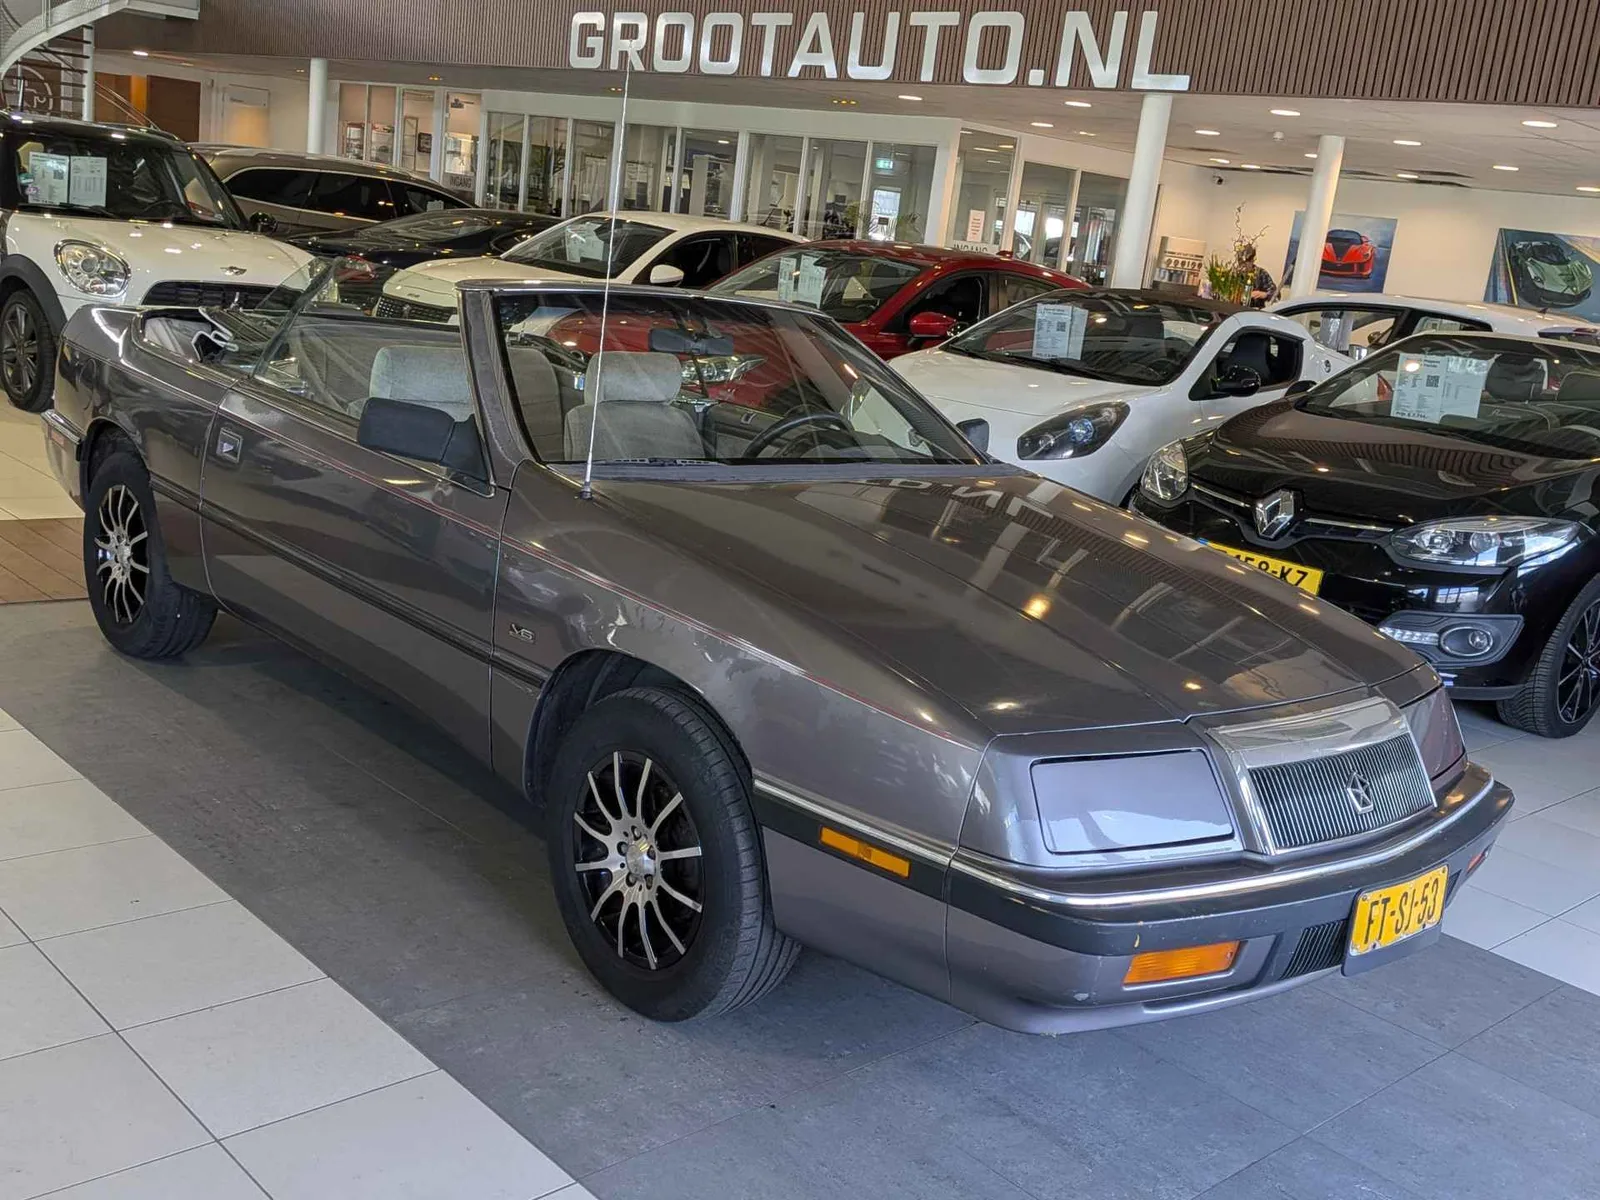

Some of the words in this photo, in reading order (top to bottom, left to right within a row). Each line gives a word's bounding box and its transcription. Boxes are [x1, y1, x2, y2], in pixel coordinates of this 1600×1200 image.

[569, 10, 1190, 91] GROOTAUTO.NL
[510, 623, 534, 642] V6
[1364, 878, 1439, 945] FT-SJ-53
